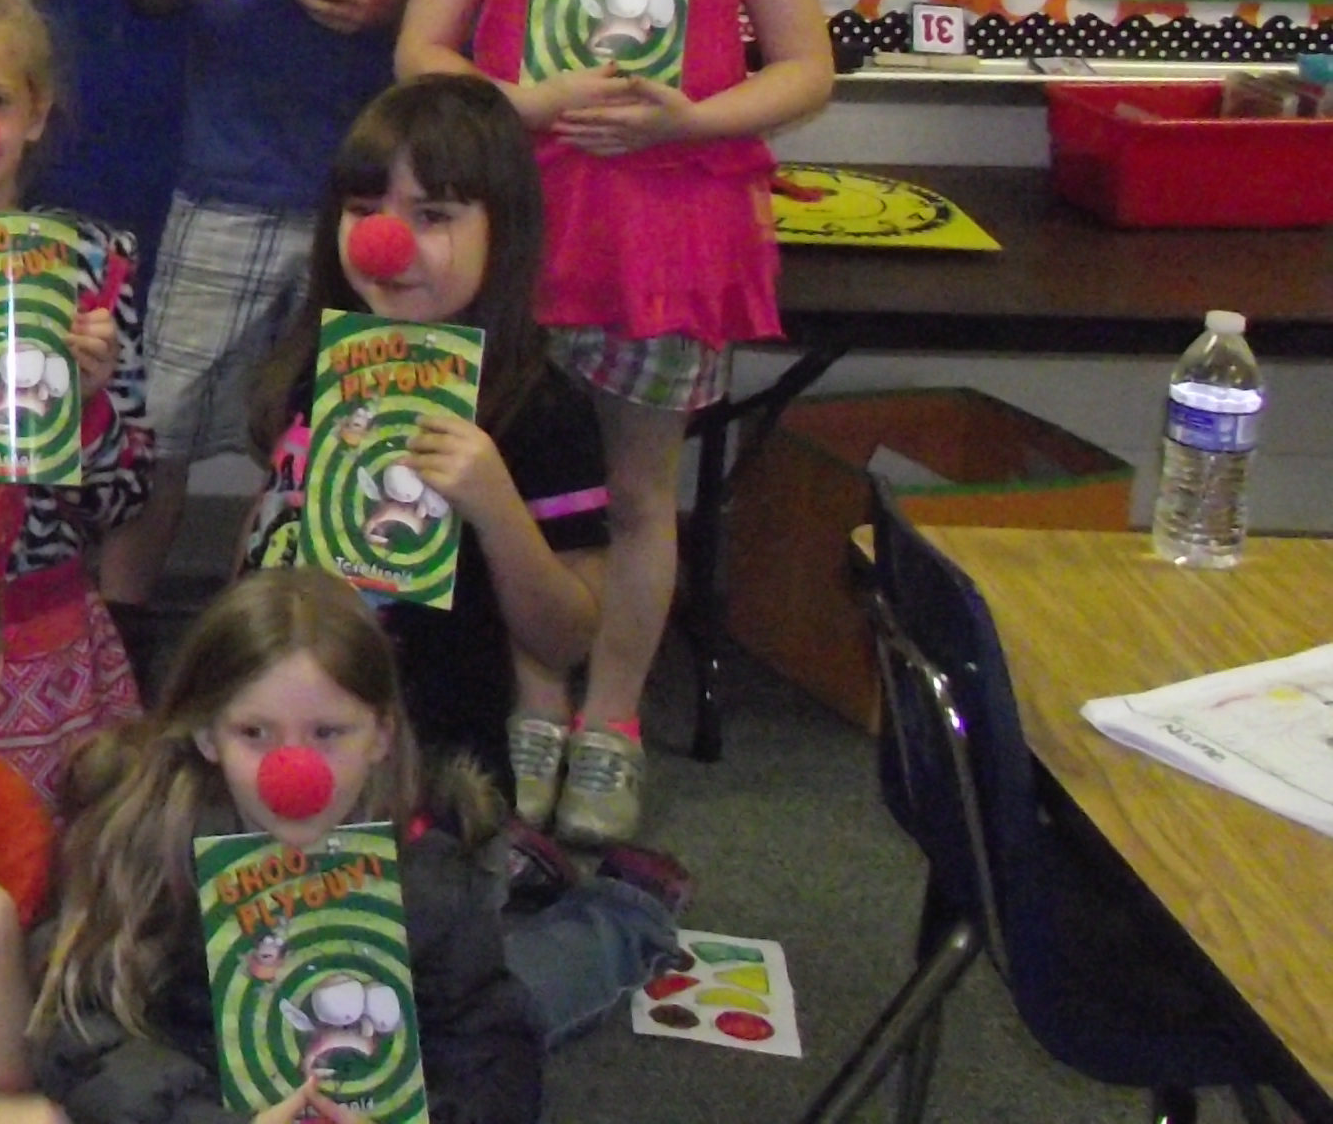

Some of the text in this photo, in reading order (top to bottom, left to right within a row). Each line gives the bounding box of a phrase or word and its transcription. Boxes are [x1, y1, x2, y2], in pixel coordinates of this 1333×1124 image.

[0, 240, 69, 281] GUY!
[396, 355, 466, 394] GUY!
[302, 852, 382, 909] GUY!
